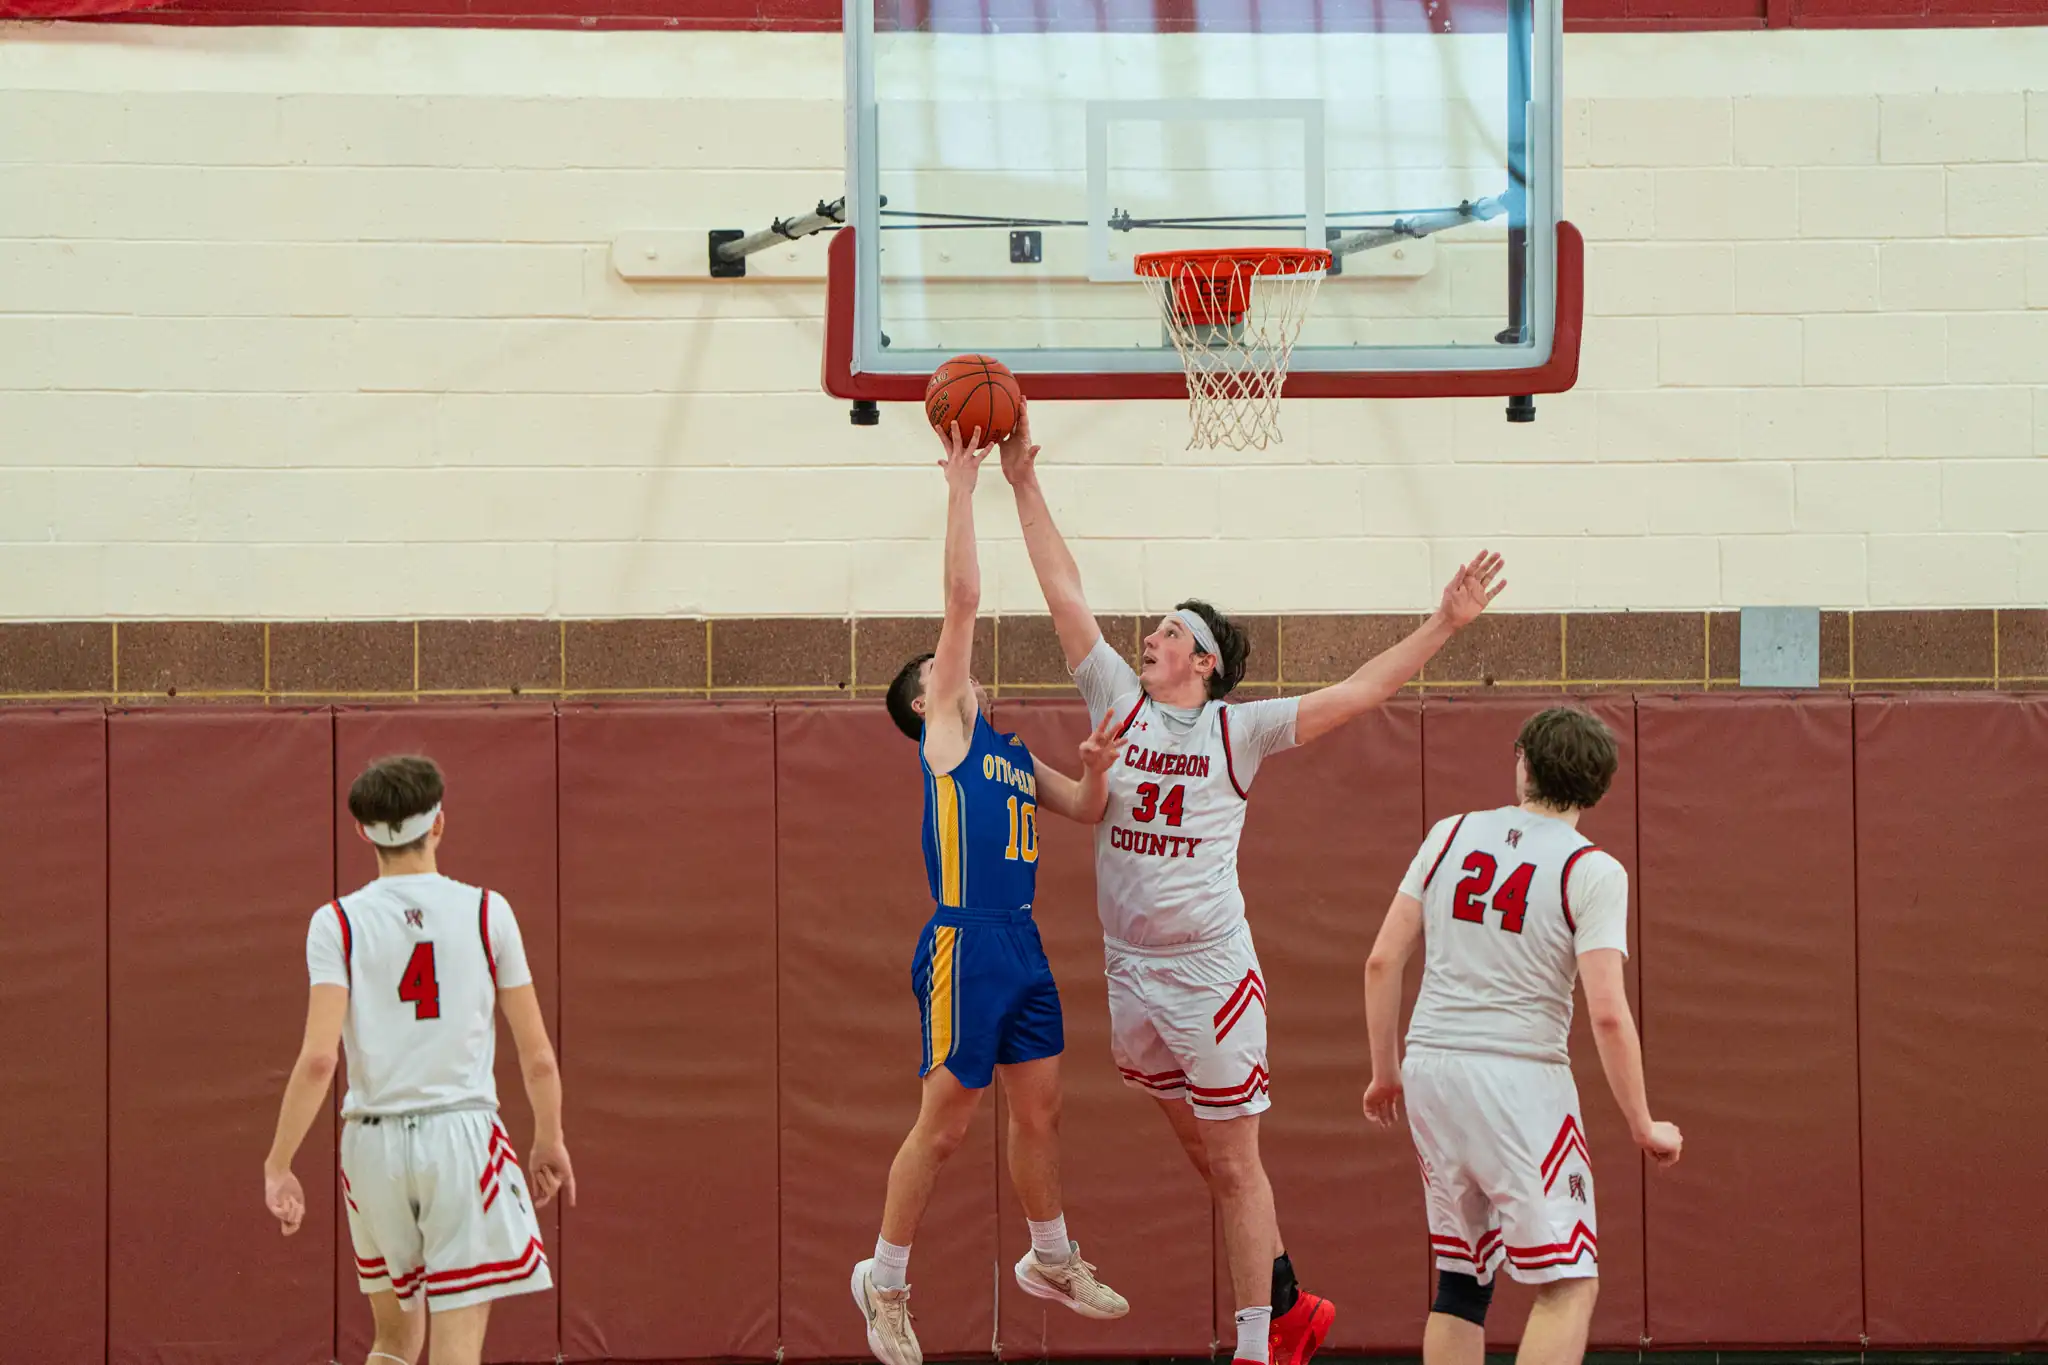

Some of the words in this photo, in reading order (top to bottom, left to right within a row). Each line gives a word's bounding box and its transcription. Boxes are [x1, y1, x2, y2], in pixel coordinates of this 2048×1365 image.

[1124, 744, 1210, 778] CAMERON
[1005, 795, 1039, 863] 10
[1132, 781, 1185, 827] 34
[1111, 825, 1202, 858] COUNTY
[1452, 850, 1537, 935] 24
[397, 940, 441, 1020] 4
